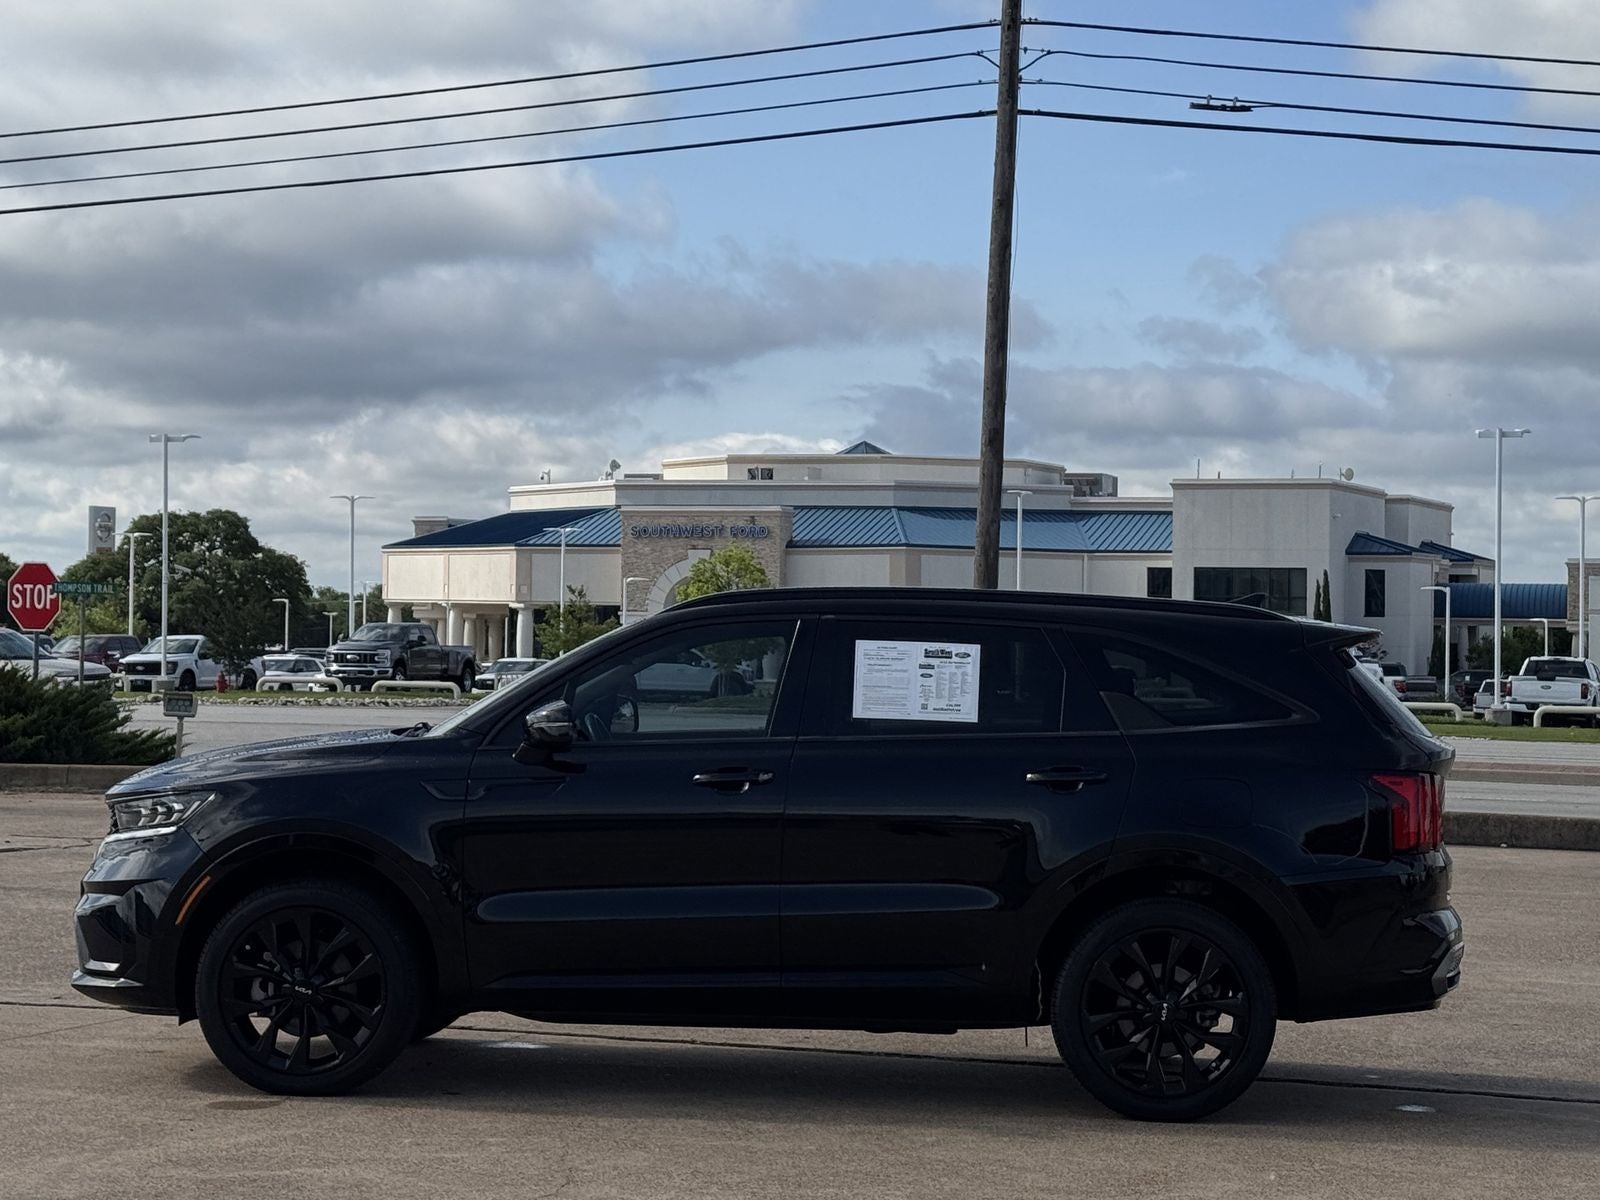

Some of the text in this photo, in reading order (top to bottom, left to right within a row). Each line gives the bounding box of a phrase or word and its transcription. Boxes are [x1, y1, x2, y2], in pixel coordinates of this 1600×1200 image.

[630, 525, 769, 538] SOUTHWEST FORD
[54, 583, 114, 594] THOMPSON TRAIL
[11, 583, 57, 609] STOP
